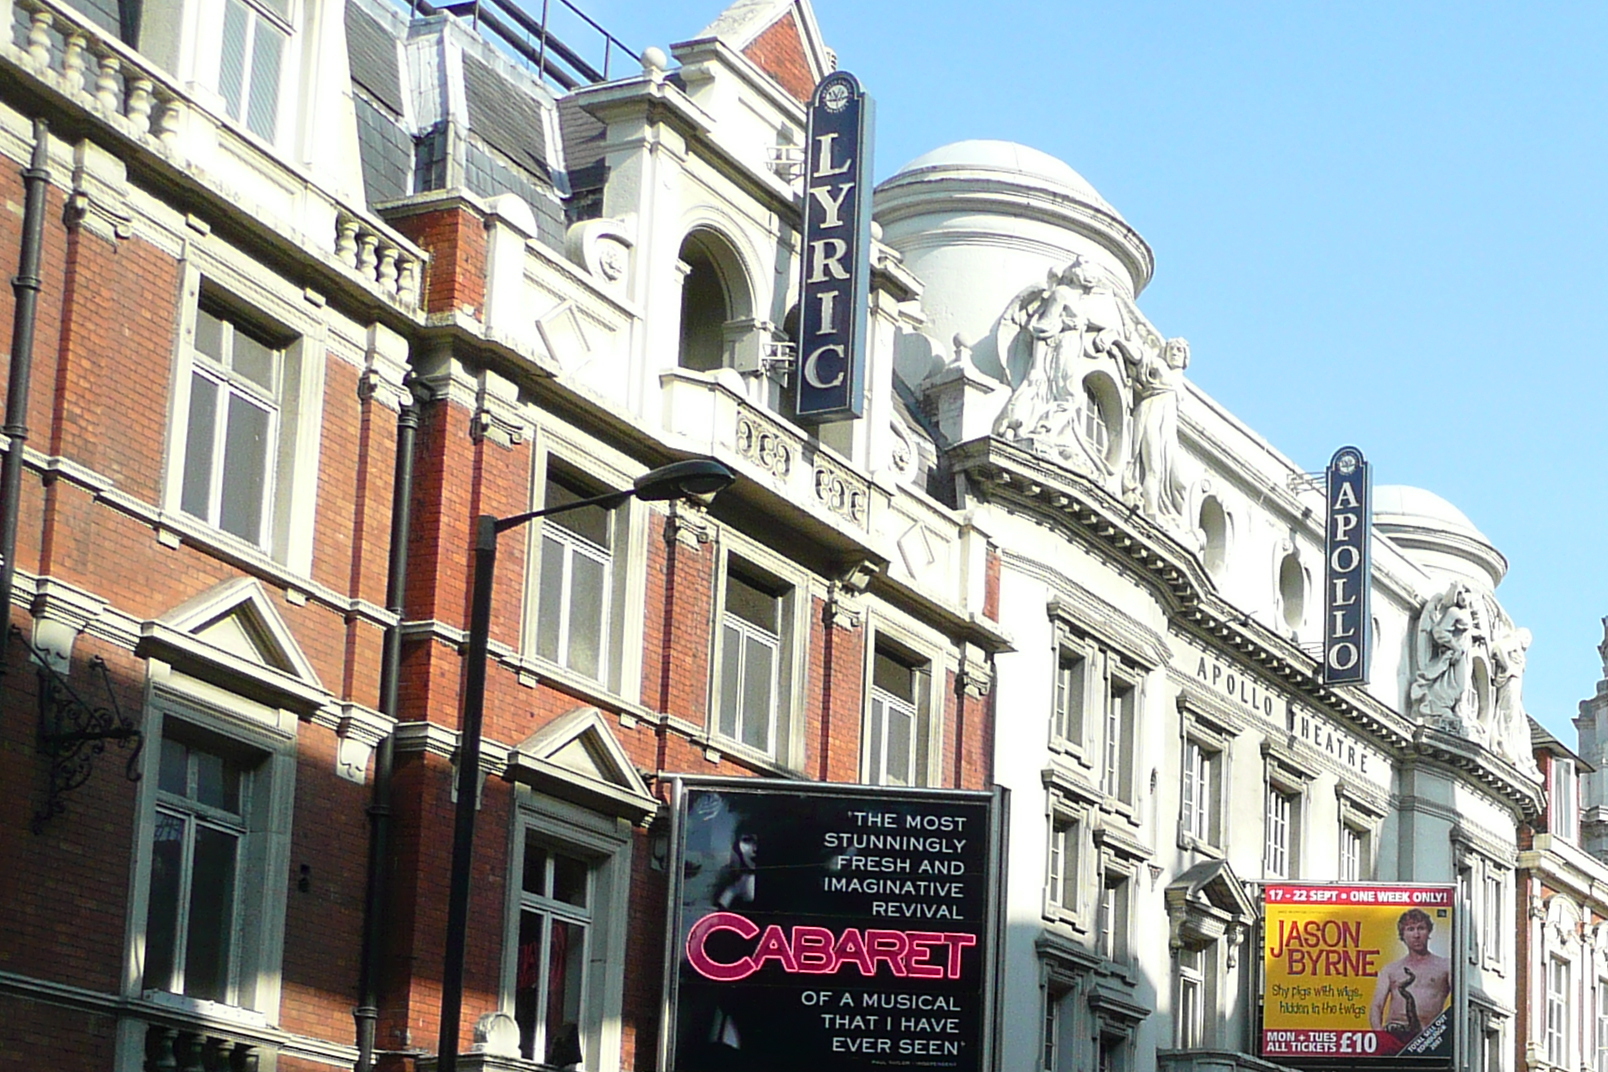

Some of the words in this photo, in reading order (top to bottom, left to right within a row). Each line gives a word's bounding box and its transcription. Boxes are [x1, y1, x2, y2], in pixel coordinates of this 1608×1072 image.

[803, 132, 856, 390] LYRIC
[1328, 481, 1361, 671] APOLLO
[1196, 655, 1273, 717] APOLLO
[1291, 707, 1369, 775] THEATRE
[905, 815, 967, 833] MOST
[823, 832, 967, 854] STUNNINGLY
[836, 856, 911, 874] FRESH
[918, 859, 966, 877] AND
[823, 876, 965, 898] IMAGINATIVE
[1268, 889, 1284, 901] 17
[1293, 889, 1307, 901] 22
[1309, 890, 1338, 901] SEPT
[1350, 891, 1376, 902] ONE
[1376, 891, 1410, 902] WEEK
[1413, 892, 1448, 903] ONLY!
[872, 901, 965, 921] REVIVAL
[685, 911, 977, 982] CABARET
[1269, 919, 1362, 959] JASON
[1286, 948, 1381, 978] BYRNE
[800, 990, 833, 1007] OF
[838, 991, 856, 1008] A
[862, 993, 962, 1012] MUSICAL
[1271, 983, 1290, 999] Shy
[1292, 985, 1312, 1000] pigs
[1313, 983, 1335, 998] with
[1279, 1000, 1310, 1015] hidden
[1311, 1001, 1320, 1015] in
[1321, 1001, 1337, 1015] the
[1338, 1002, 1367, 1019] twigs
[820, 1013, 878, 1031] THAT
[886, 1015, 893, 1032] I
[900, 1016, 961, 1034] HAVE
[1435, 1014, 1448, 1027] OUT
[831, 1037, 892, 1053] EVER
[1266, 1031, 1296, 1042] MON
[1297, 1034, 1306, 1042] +
[1308, 1032, 1337, 1042] TUES
[1339, 1032, 1377, 1053] £10
[1266, 1042, 1288, 1052] ALL
[1290, 1042, 1337, 1052] TICKETS
